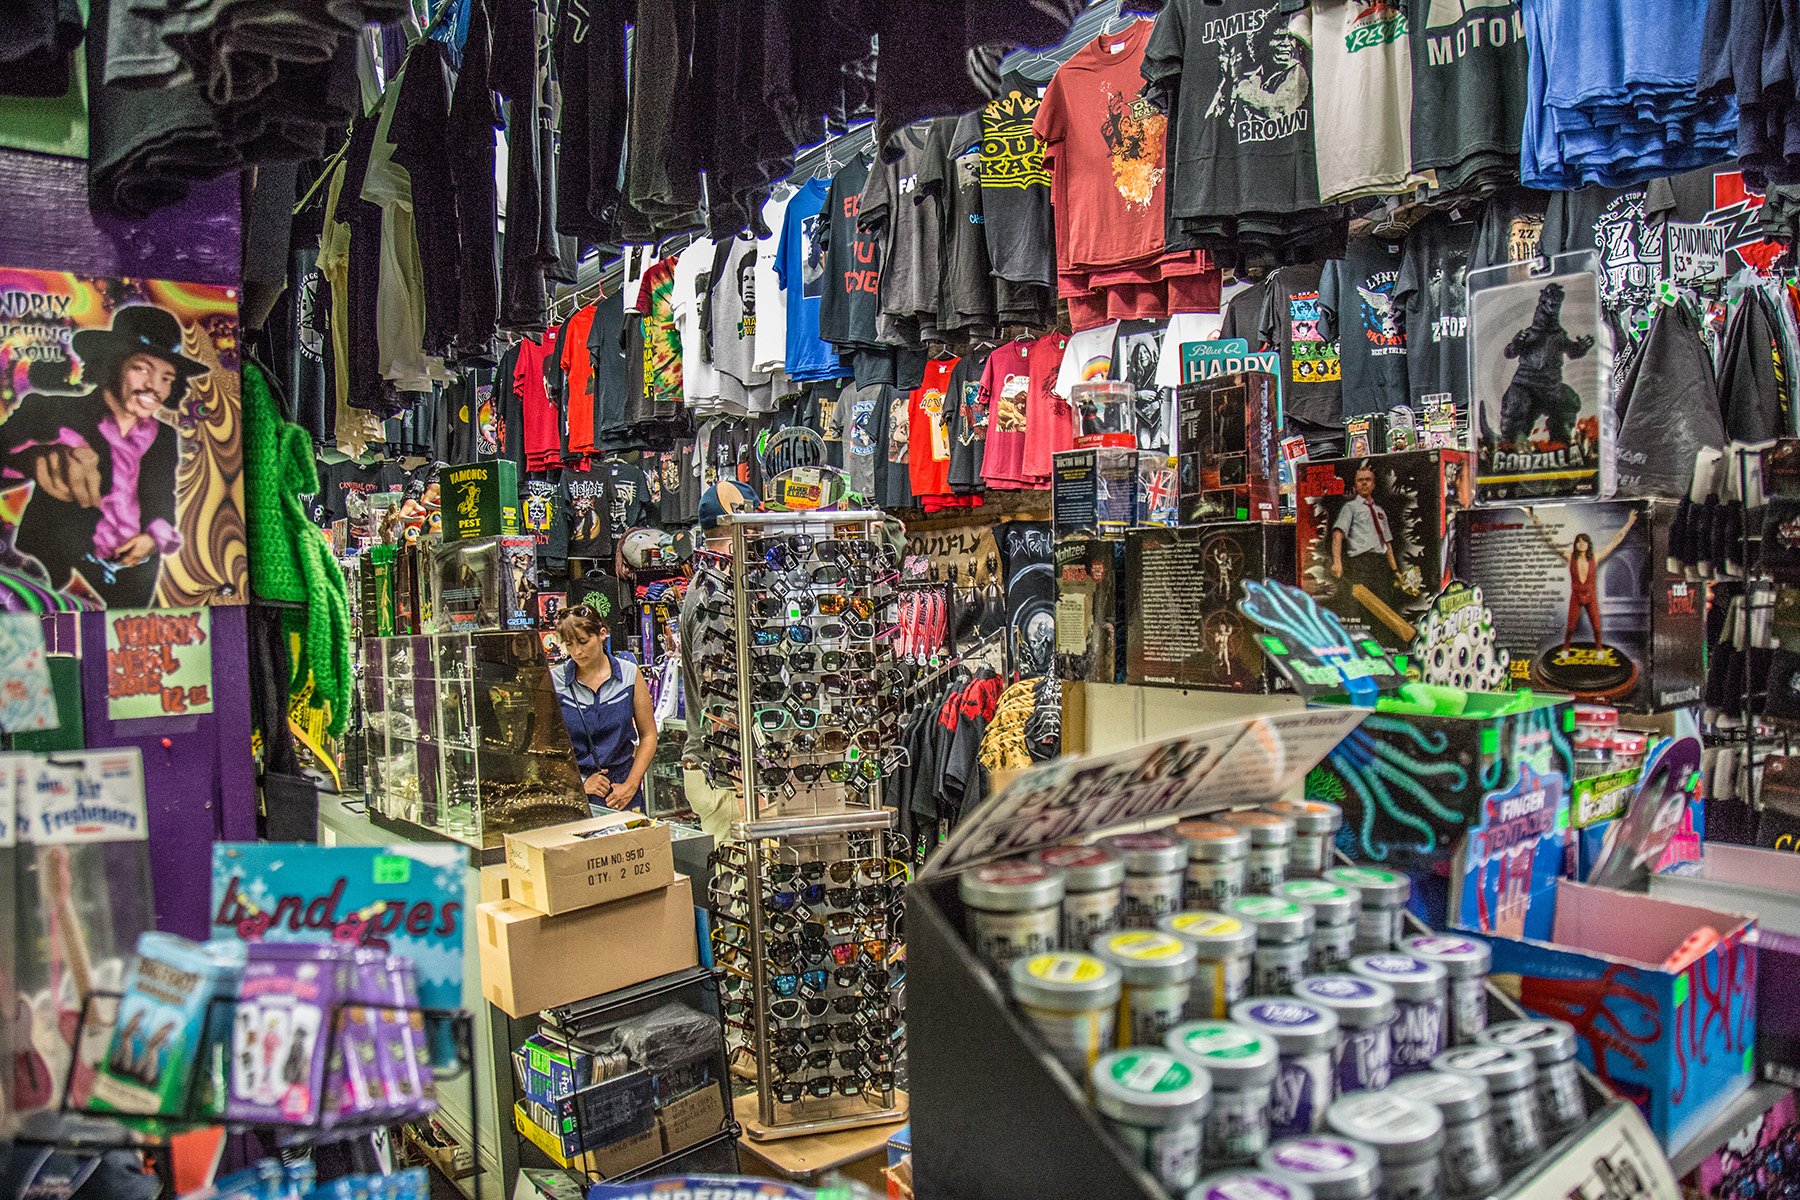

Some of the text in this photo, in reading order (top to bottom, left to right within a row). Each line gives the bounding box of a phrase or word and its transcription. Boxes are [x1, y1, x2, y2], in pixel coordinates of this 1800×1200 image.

[1202, 8, 1267, 45] JAMES
[1237, 108, 1308, 145] BROWN
[1606, 191, 1642, 212] CAN'T STOP
[1518, 229, 1535, 239] ZZ
[1606, 220, 1664, 267] ZZ
[1440, 316, 1467, 338] TOP
[13, 343, 66, 362] SOUL
[1189, 342, 1242, 357] Blue Q
[1189, 355, 1275, 383] HAPPY
[1493, 445, 1585, 472] GODZILLA
[450, 468, 488, 485] VAMONOS
[458, 517, 481, 529] PEST
[1055, 544, 1086, 563] Yahtzee
[507, 617, 535, 626] GREMLIN
[1500, 788, 1546, 822] FINGER
[587, 855, 608, 871] ITEM
[620, 867, 627, 879] 2
[634, 862, 651, 877] DZS
